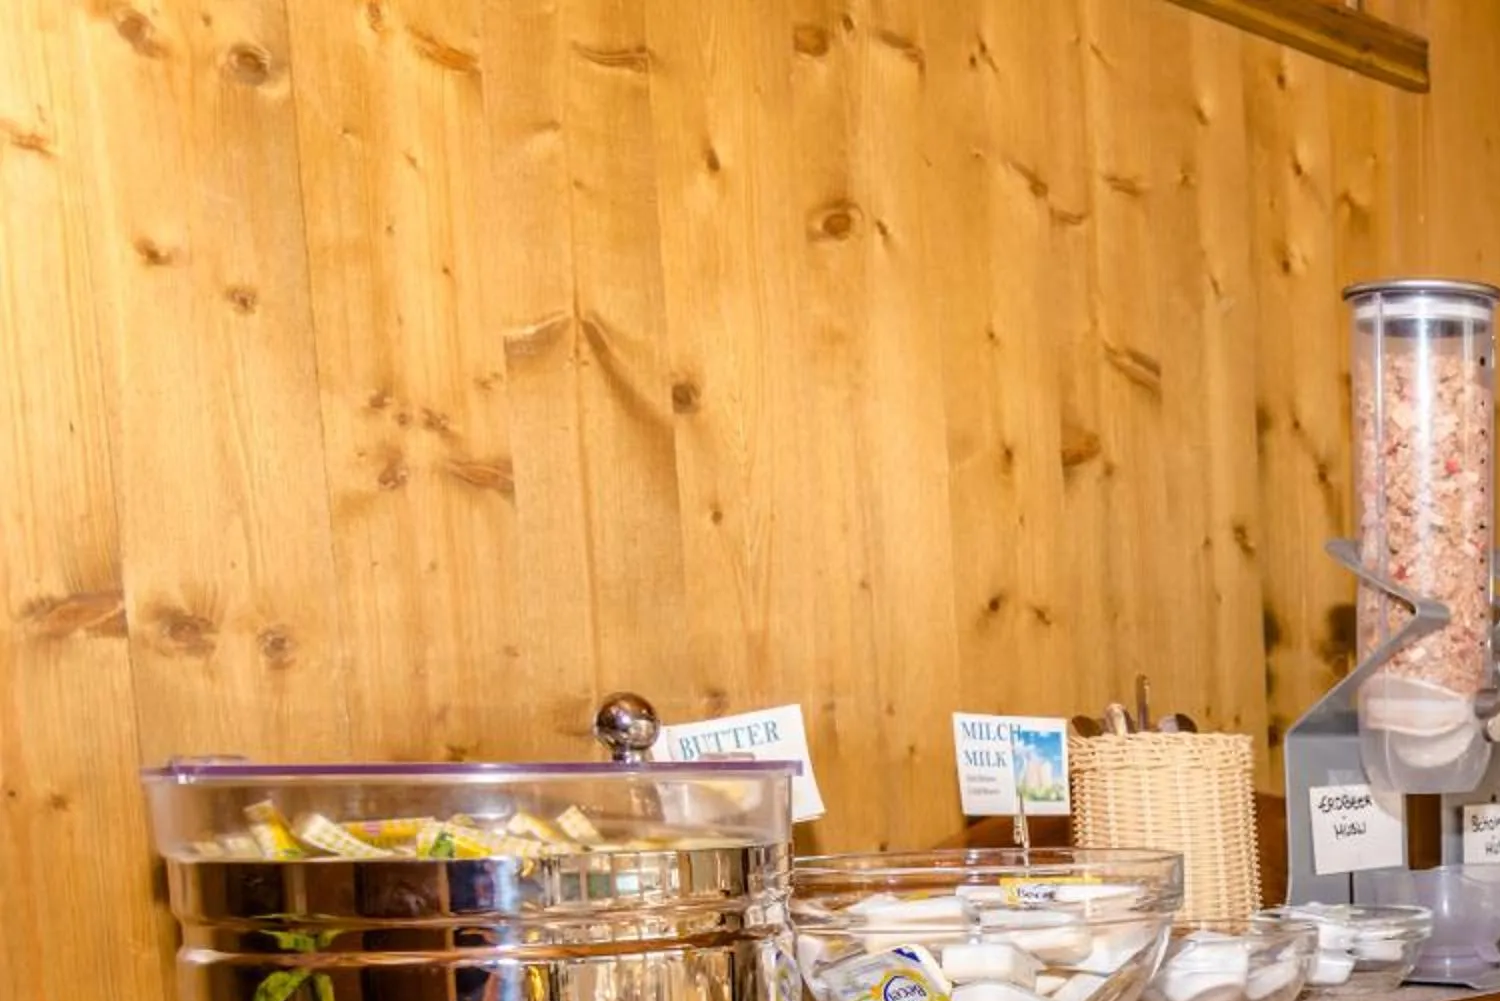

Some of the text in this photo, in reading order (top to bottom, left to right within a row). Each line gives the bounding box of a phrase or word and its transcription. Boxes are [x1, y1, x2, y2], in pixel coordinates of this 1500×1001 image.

[679, 719, 780, 760] BUTTER
[961, 721, 1021, 741] MILCH
[964, 750, 1007, 768] MILK
